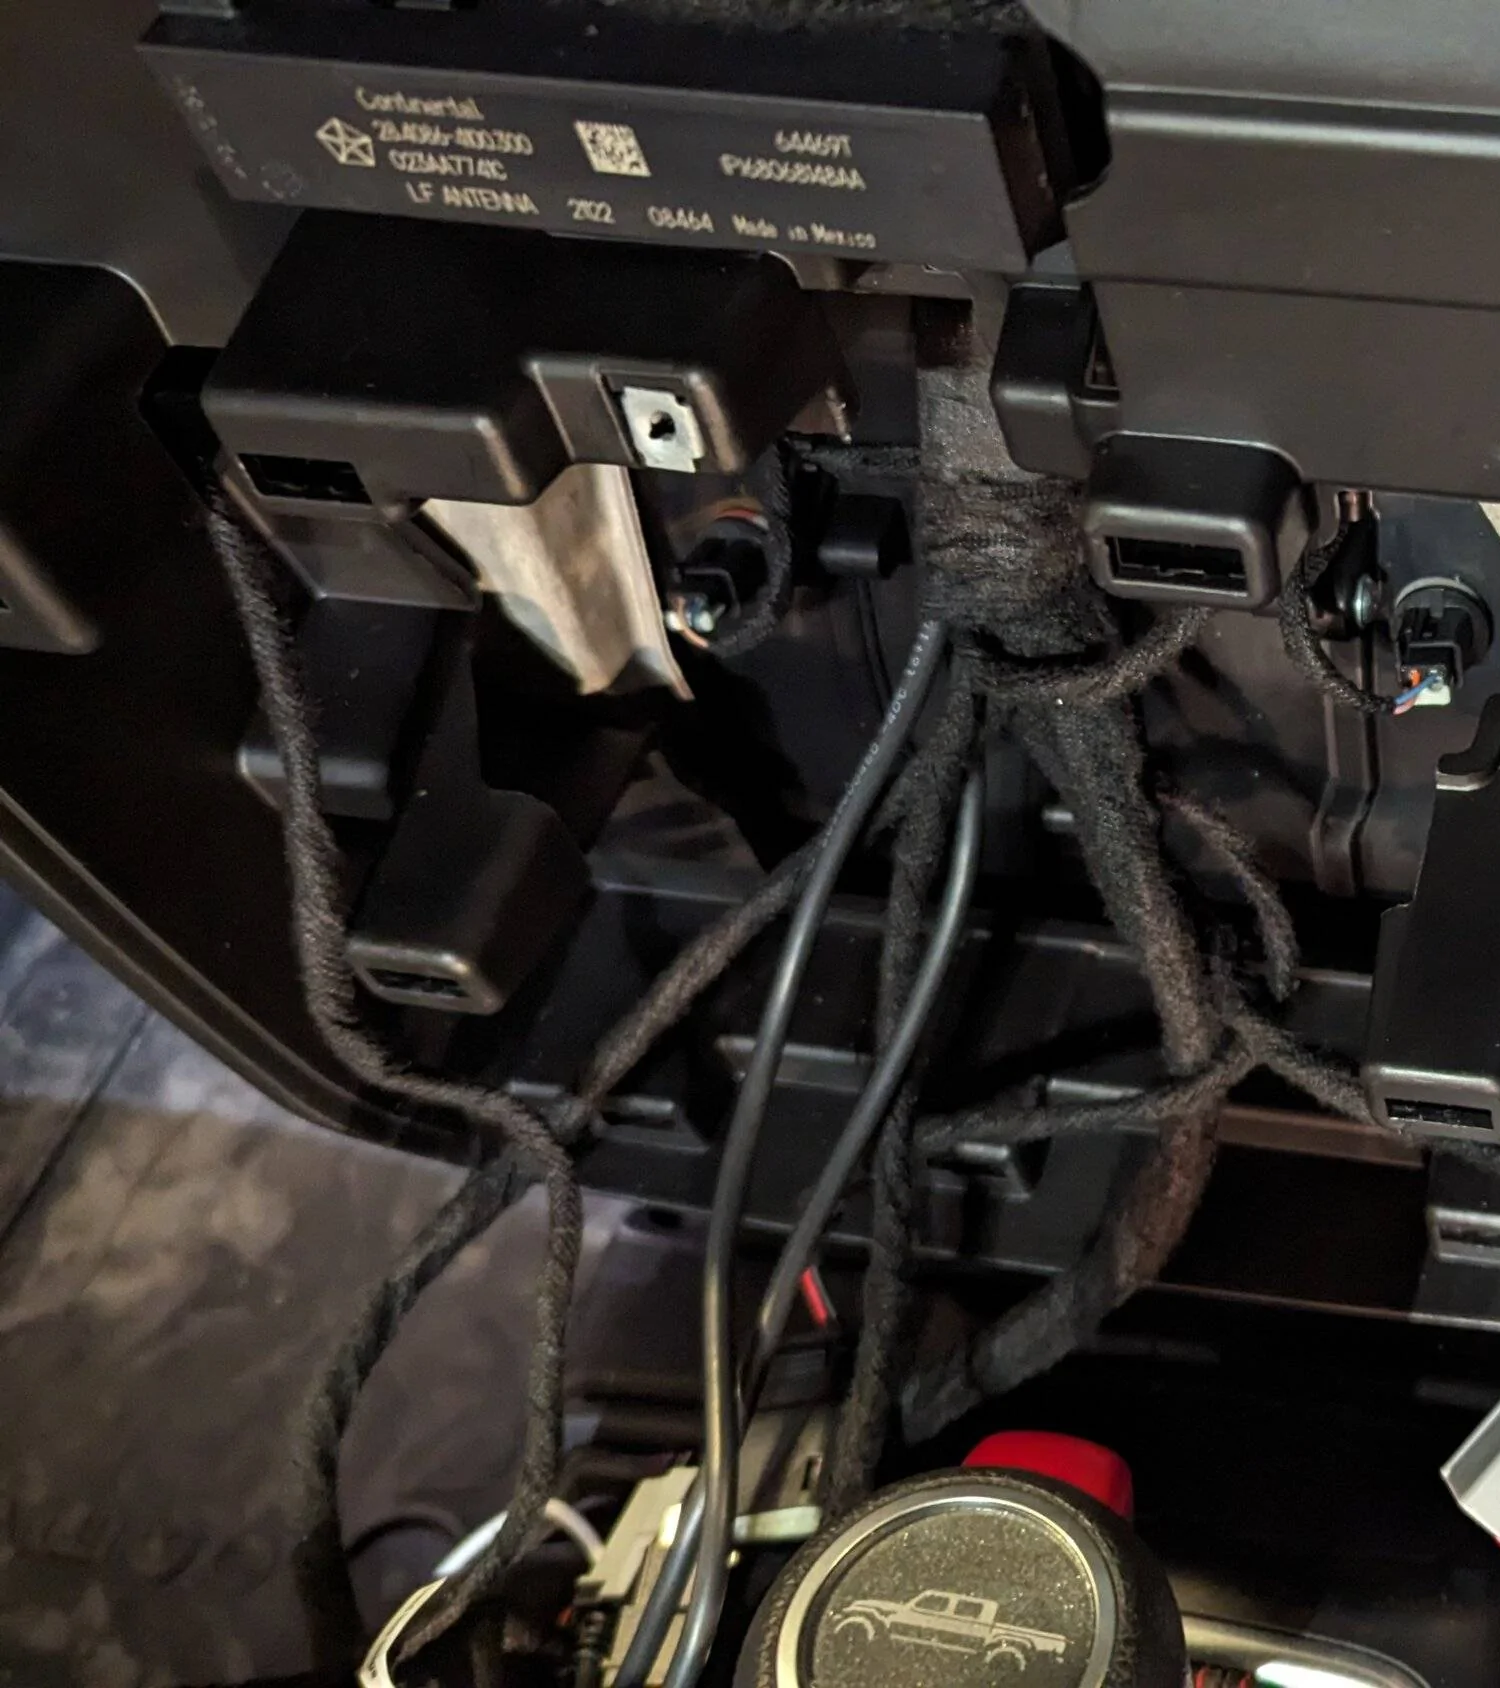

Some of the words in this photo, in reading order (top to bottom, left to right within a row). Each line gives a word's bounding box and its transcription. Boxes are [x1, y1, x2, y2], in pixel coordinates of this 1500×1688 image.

[355, 86, 484, 120] Continental
[406, 180, 434, 204] LF
[442, 185, 541, 215] ANTENNA
[731, 215, 779, 240] Made
[787, 225, 808, 241] in
[810, 222, 877, 250] Mexico
